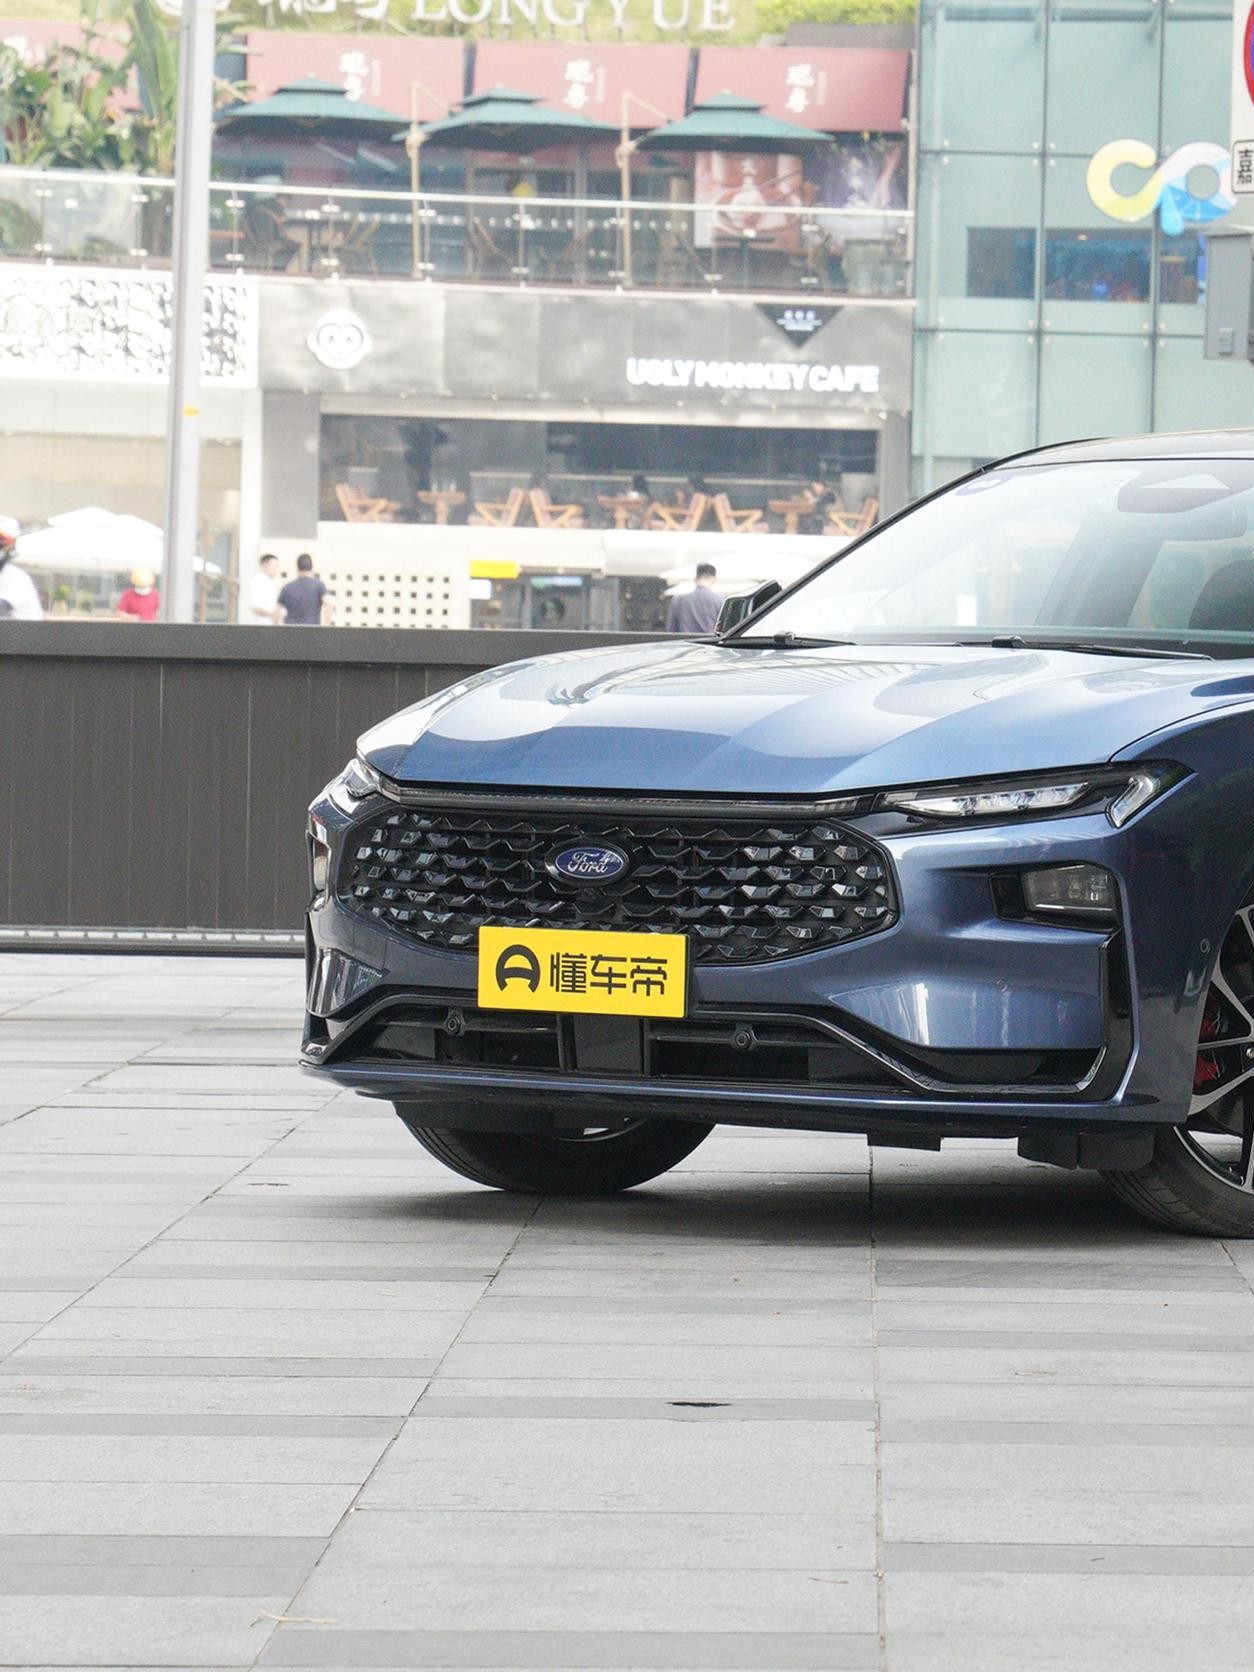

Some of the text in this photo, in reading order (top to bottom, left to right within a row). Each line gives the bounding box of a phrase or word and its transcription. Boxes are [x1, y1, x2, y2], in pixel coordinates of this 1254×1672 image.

[626, 357, 880, 393] UGLY MONKEY CAFE
[567, 850, 611, 873] Ford
[550, 952, 668, 997] 懂车帝
